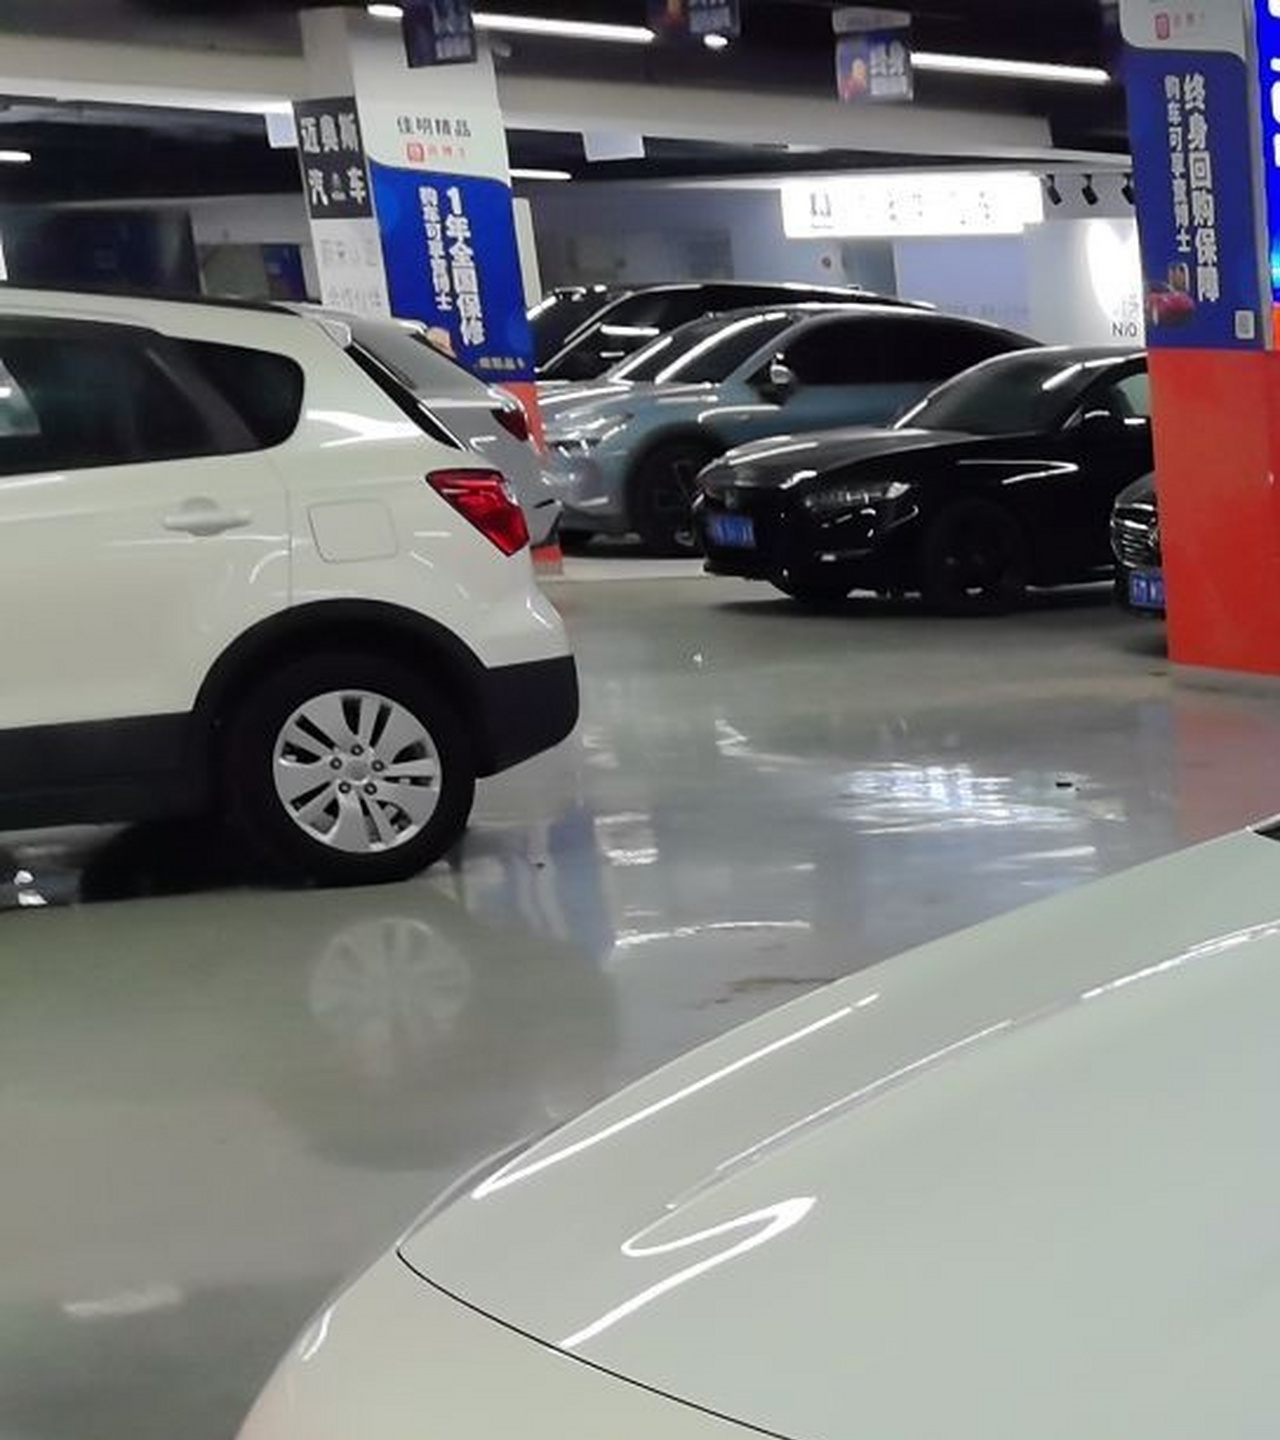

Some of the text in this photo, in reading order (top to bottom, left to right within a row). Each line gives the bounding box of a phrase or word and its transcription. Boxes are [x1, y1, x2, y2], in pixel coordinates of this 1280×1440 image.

[1183, 72, 1220, 302] 终身回购保障
